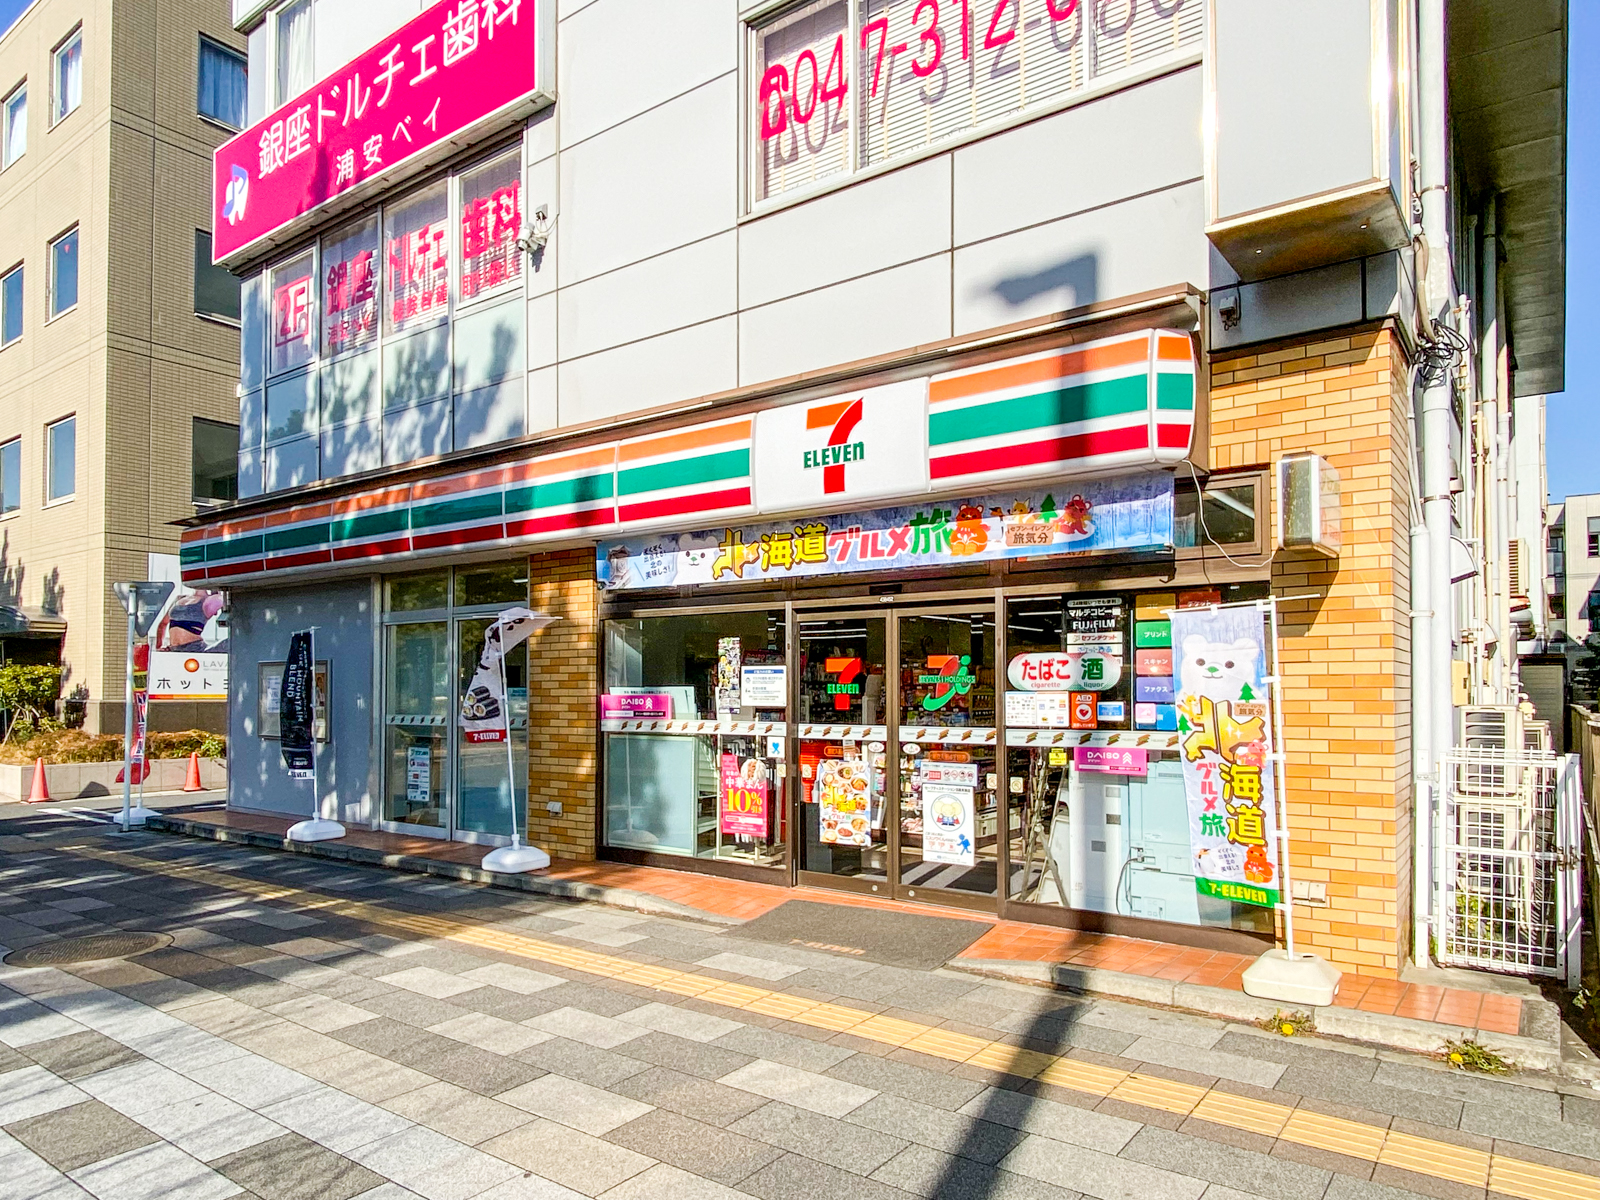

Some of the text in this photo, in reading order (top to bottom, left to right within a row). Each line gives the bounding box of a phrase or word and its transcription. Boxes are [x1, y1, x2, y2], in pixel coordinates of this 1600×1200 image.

[336, 97, 441, 186] 浦安ベイ
[1013, 532, 1050, 545] 旅気分
[1072, 619, 1116, 630] FUJIFILM
[1021, 658, 1071, 680] たばこ
[1081, 658, 1104, 680] 酒
[287, 664, 297, 698] BLEND
[1030, 680, 1061, 689] cigarette
[1083, 680, 1105, 689] liquor
[1075, 694, 1093, 702] AED
[1087, 751, 1120, 759] DAISO
[725, 776, 764, 790] 中華まん
[726, 788, 763, 813] 10%
[1196, 762, 1227, 839] グルメ旅
